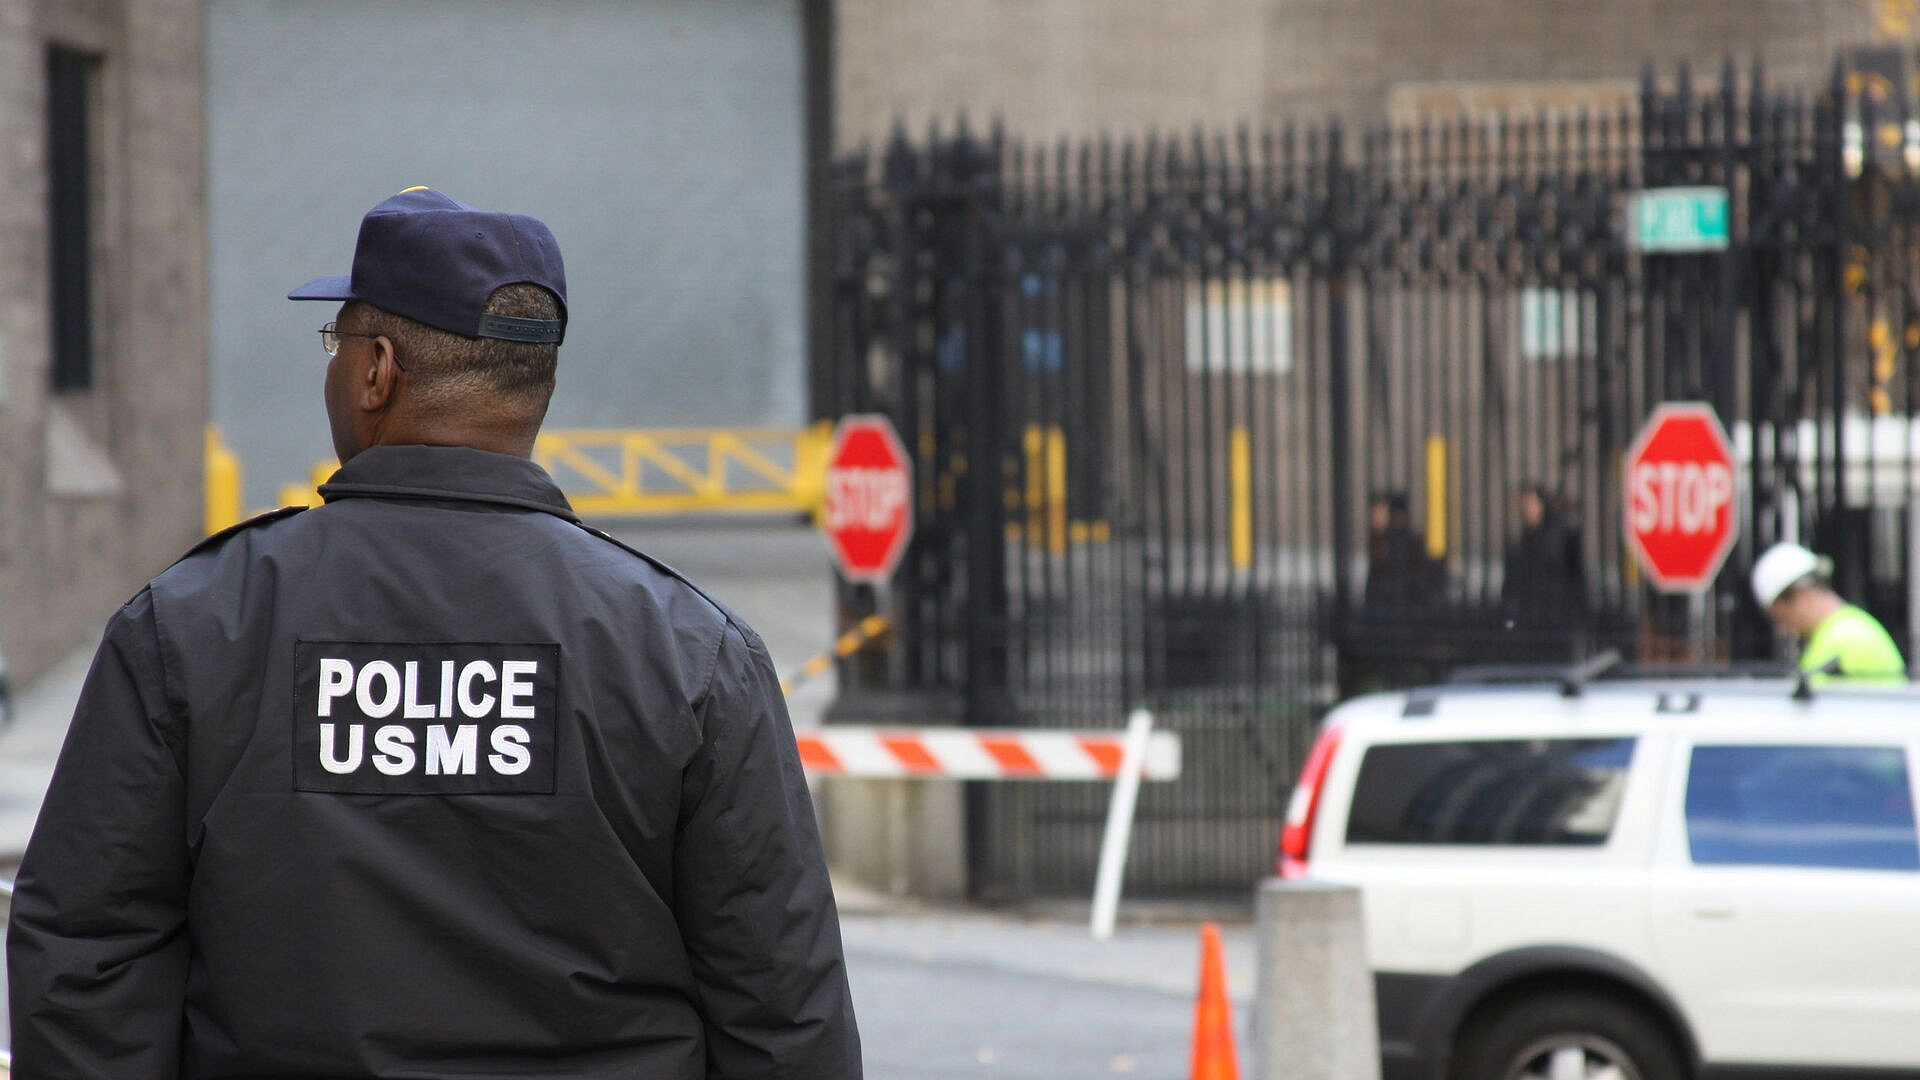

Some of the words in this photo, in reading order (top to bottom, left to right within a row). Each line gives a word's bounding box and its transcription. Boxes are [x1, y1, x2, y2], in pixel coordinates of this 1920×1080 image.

[828, 469, 909, 528] STOP
[1635, 463, 1731, 534] STOP
[317, 658, 537, 718] POLICE
[319, 723, 531, 775] USMS
